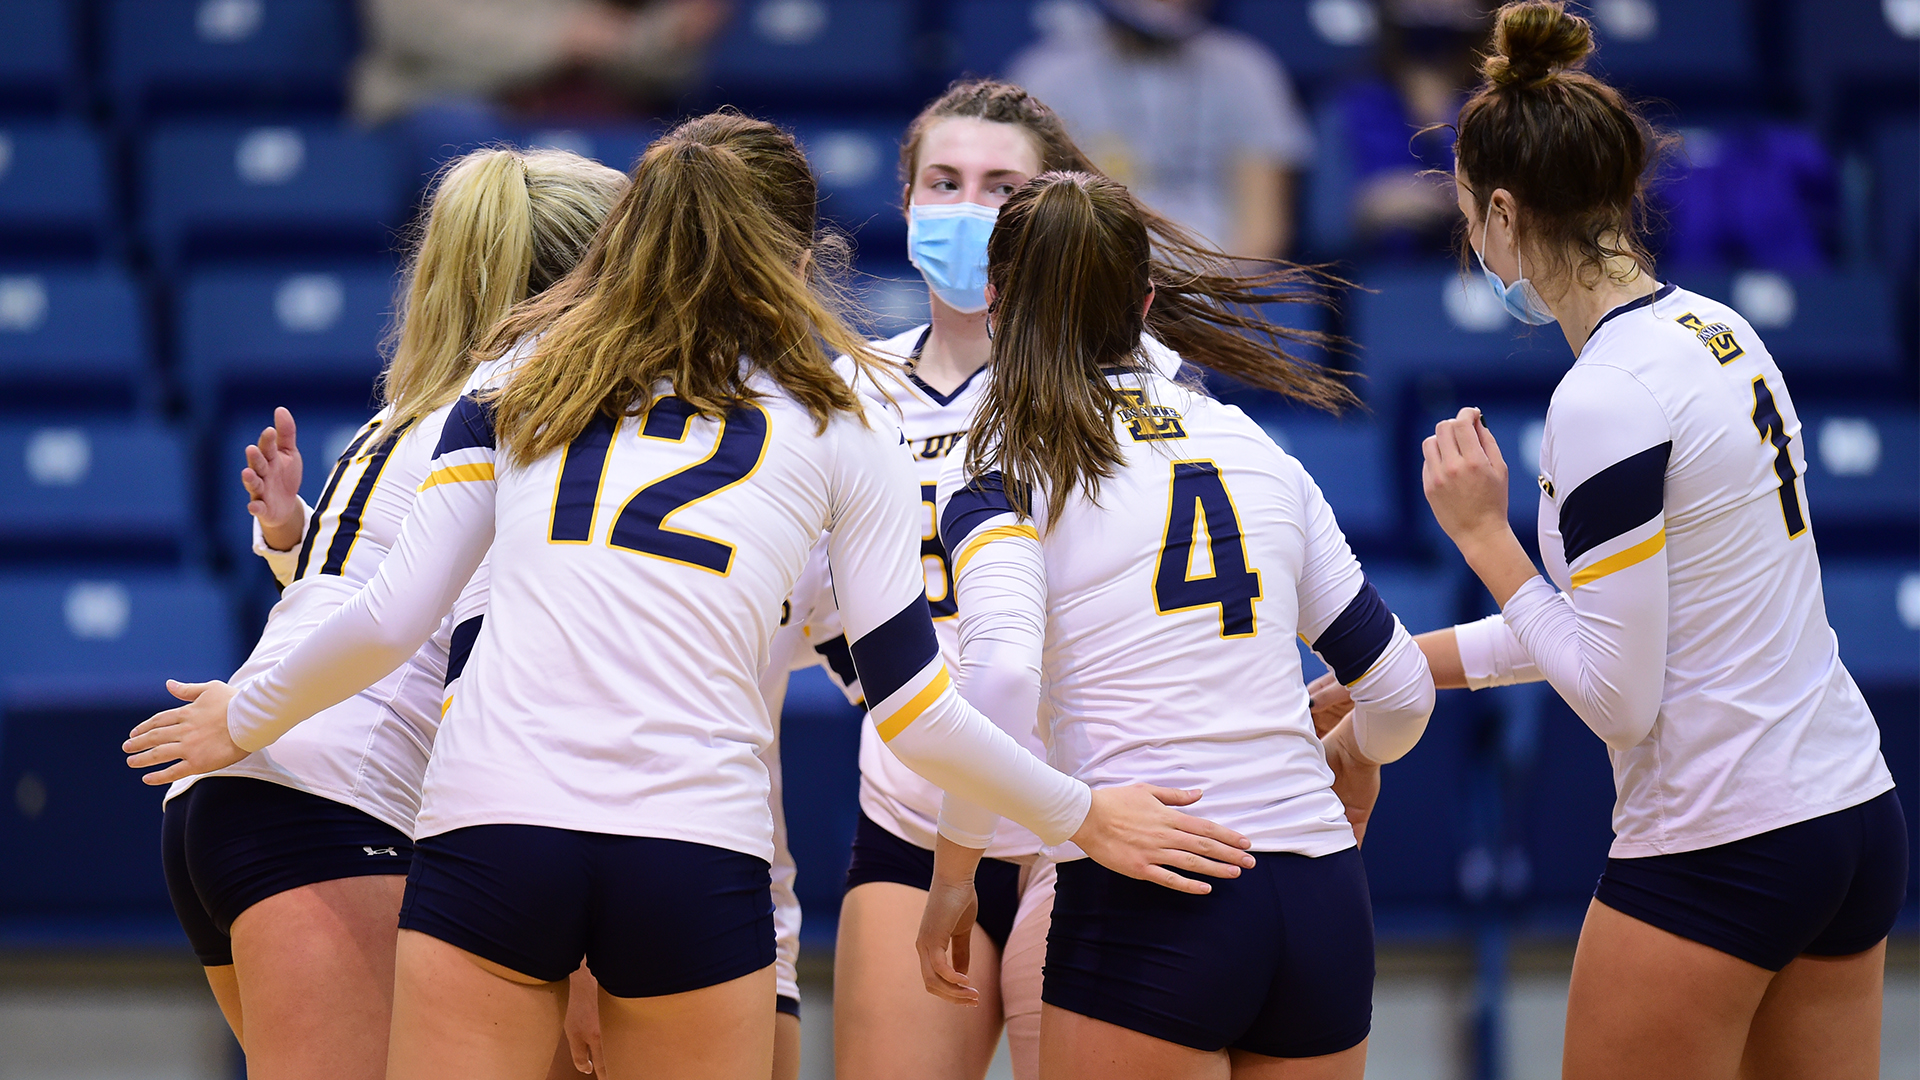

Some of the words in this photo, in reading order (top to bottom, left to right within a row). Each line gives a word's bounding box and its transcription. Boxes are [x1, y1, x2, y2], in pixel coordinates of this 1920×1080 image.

[293, 414, 419, 578] 11
[547, 393, 773, 578] 12
[1751, 373, 1807, 541] 1
[1151, 458, 1264, 640] 4
